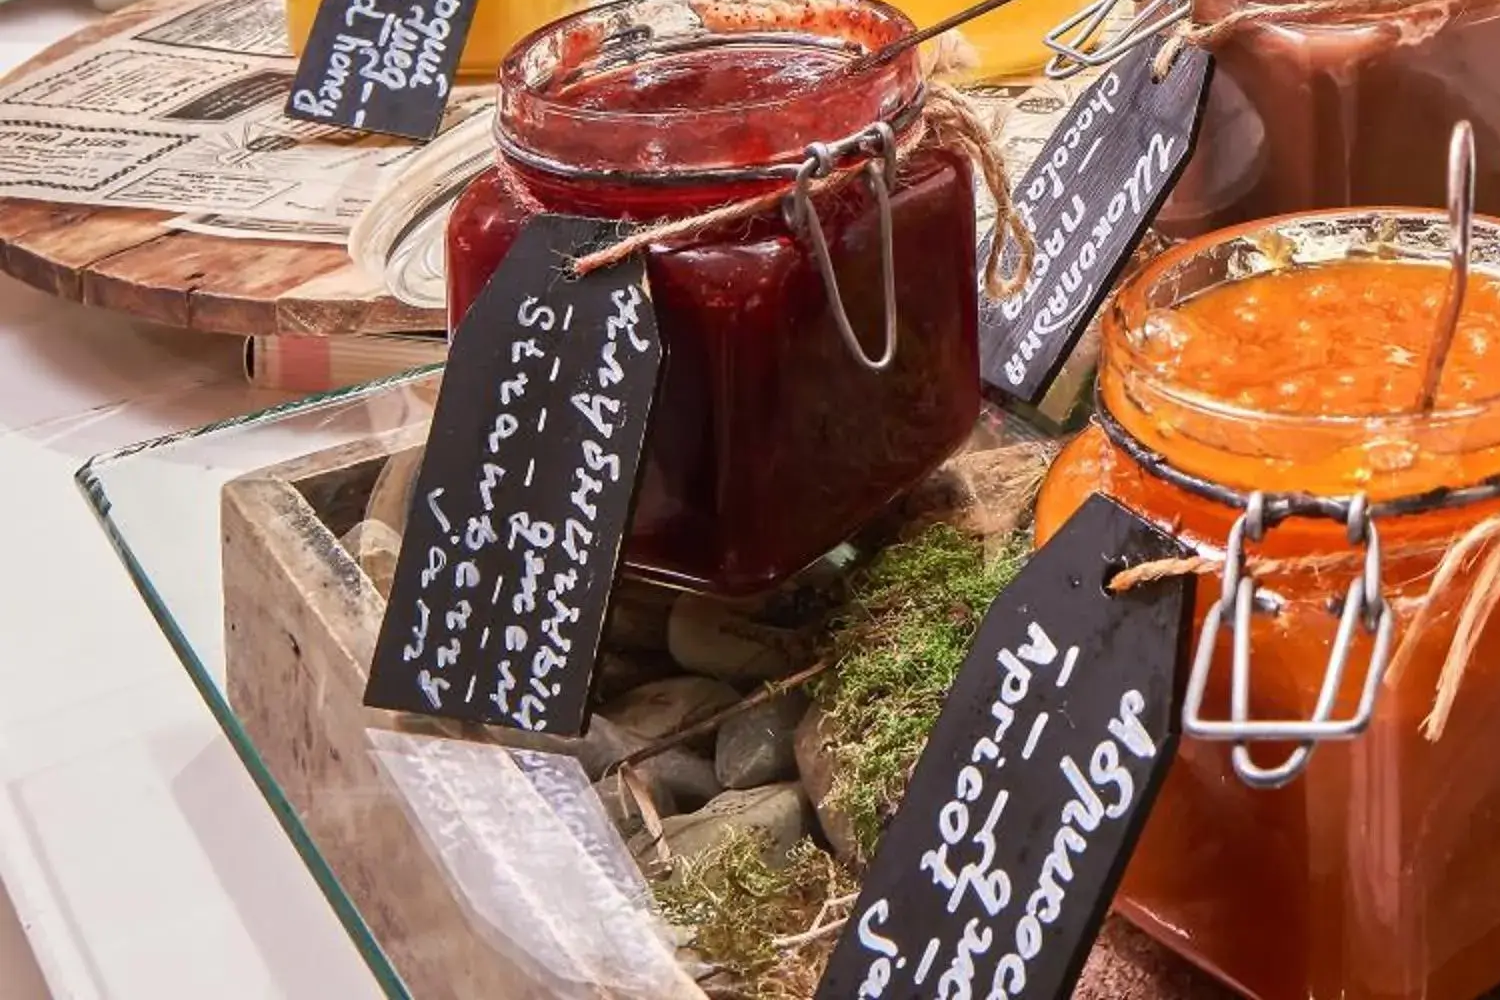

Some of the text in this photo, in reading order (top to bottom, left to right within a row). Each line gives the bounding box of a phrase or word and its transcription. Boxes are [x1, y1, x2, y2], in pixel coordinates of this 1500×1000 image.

[293, 34, 373, 117] honey
[919, 622, 1060, 887] Apricot
[857, 899, 907, 1000] ja
